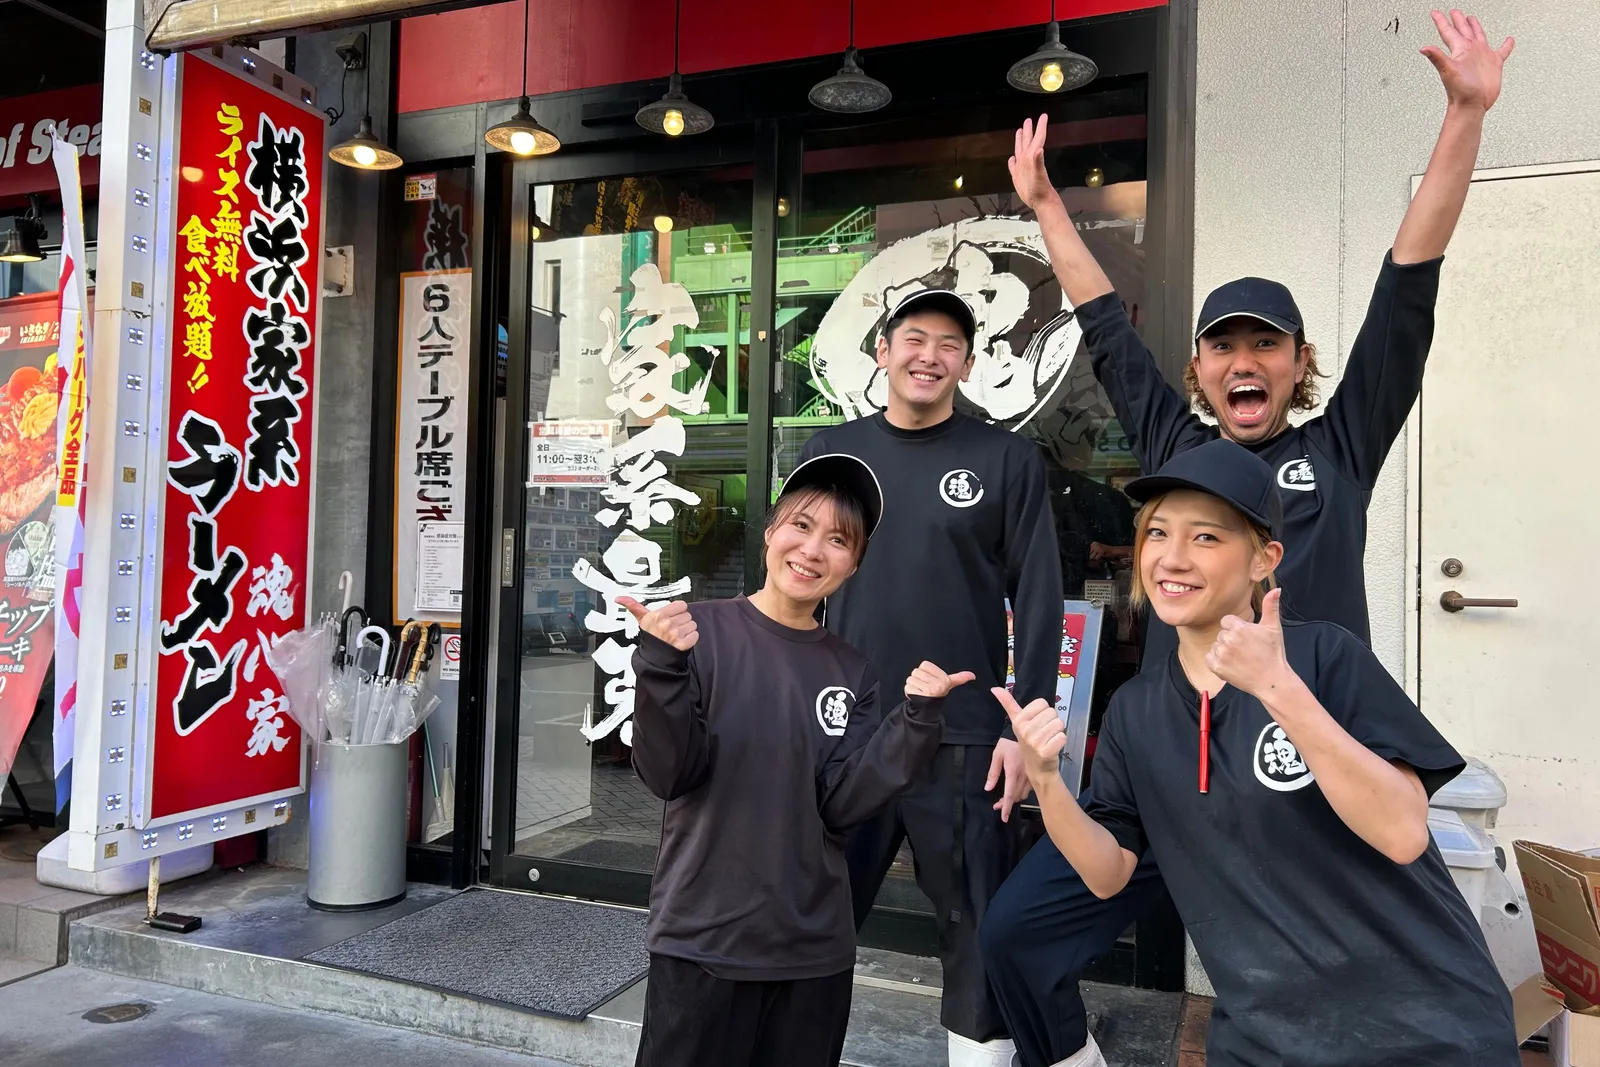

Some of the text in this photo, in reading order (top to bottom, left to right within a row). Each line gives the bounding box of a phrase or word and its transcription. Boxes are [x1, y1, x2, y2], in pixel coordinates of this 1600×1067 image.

[211, 102, 243, 283] ライス無料
[246, 114, 308, 486] 横浜家系
[536, 443, 550, 452] 全日
[162, 412, 245, 735] ラーメン
[1539, 938, 1597, 996] ニンニク
